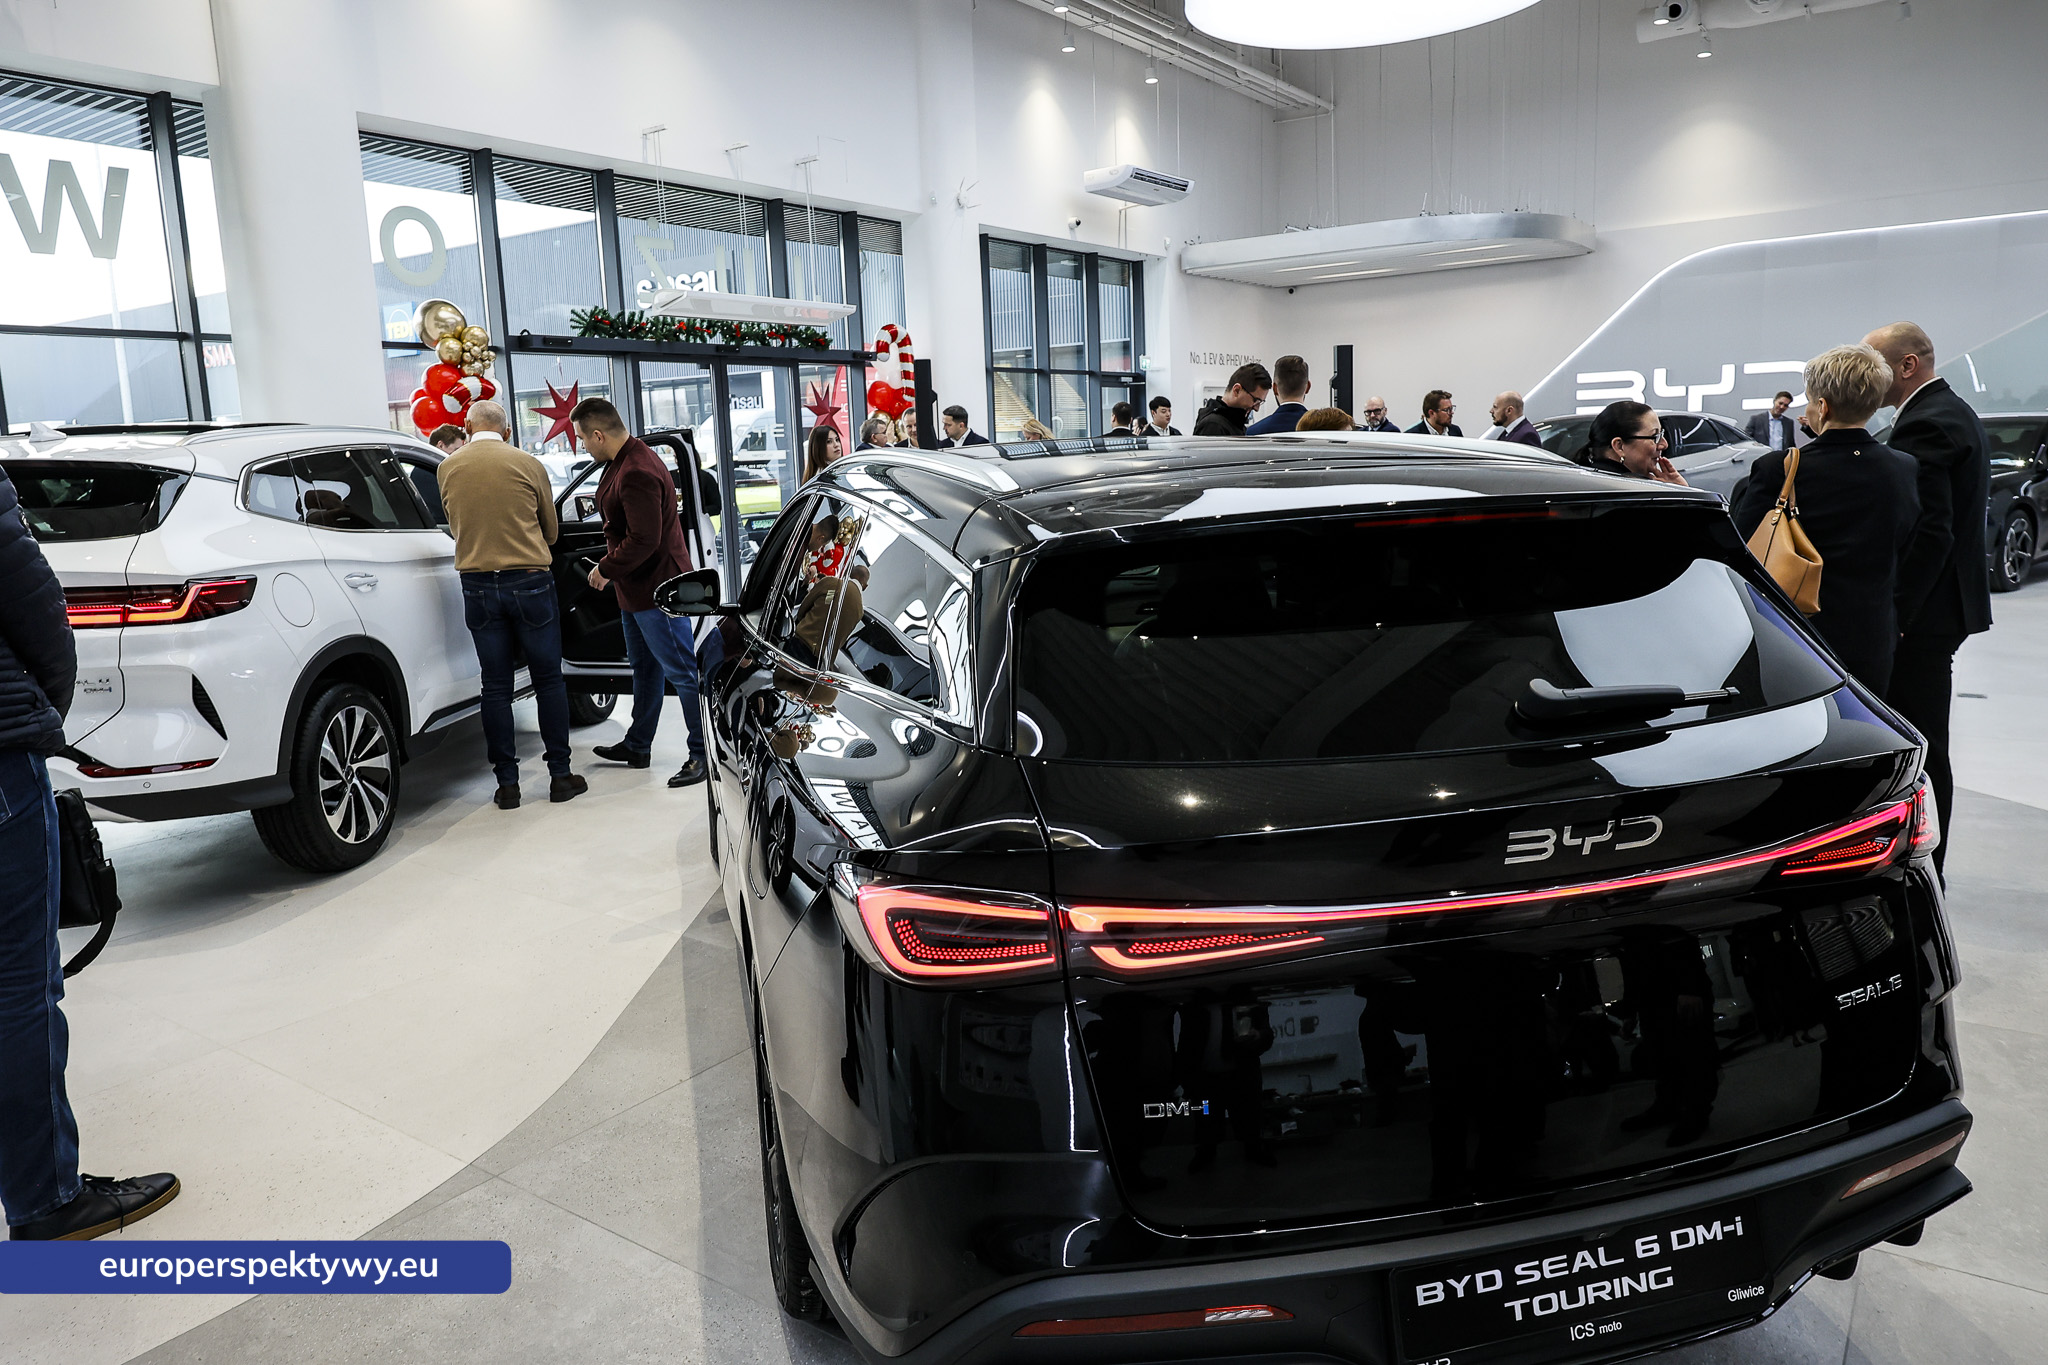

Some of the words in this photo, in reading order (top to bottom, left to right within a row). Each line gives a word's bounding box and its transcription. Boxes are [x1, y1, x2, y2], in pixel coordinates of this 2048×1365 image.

[1209, 352, 1218, 365] EV
[1227, 354, 1243, 367] PHEV
[1575, 360, 1809, 415] BYD
[1504, 815, 1664, 865] BYD
[1835, 981, 1890, 1010] SEAL
[1143, 1100, 1210, 1119] DM-i
[1415, 1268, 1503, 1307] BYD
[1514, 1246, 1625, 1286] SEAL
[1634, 1234, 1661, 1260] 6
[1670, 1215, 1744, 1252] DM-i
[1504, 1265, 1674, 1322] TOURING
[1727, 1284, 1765, 1302] Gliwice
[1570, 1322, 1595, 1341] ICS
[1599, 1320, 1622, 1335] moto
